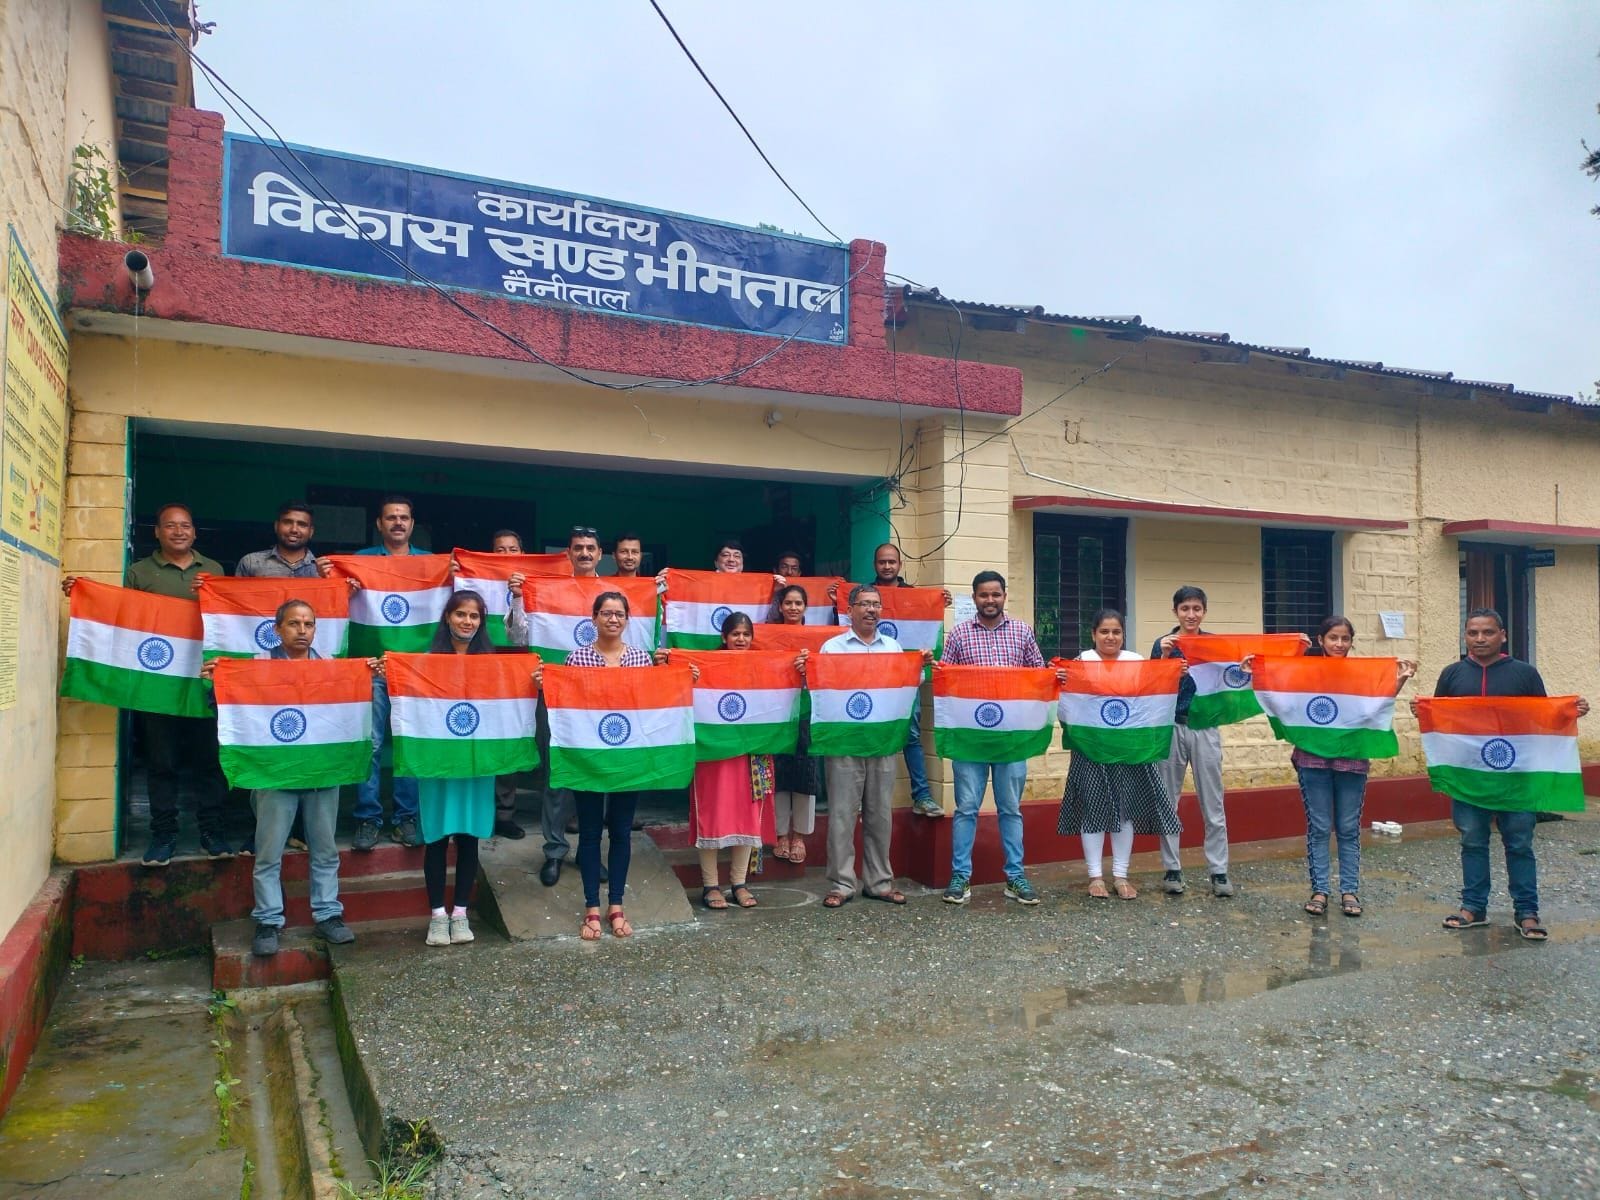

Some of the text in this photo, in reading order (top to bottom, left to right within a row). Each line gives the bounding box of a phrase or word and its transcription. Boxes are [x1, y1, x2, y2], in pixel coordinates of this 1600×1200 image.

[248, 171, 842, 315] विकास खण्ड भीमताल
[476, 190, 659, 246] कार्यालय
[502, 269, 631, 311] नैनीताल
